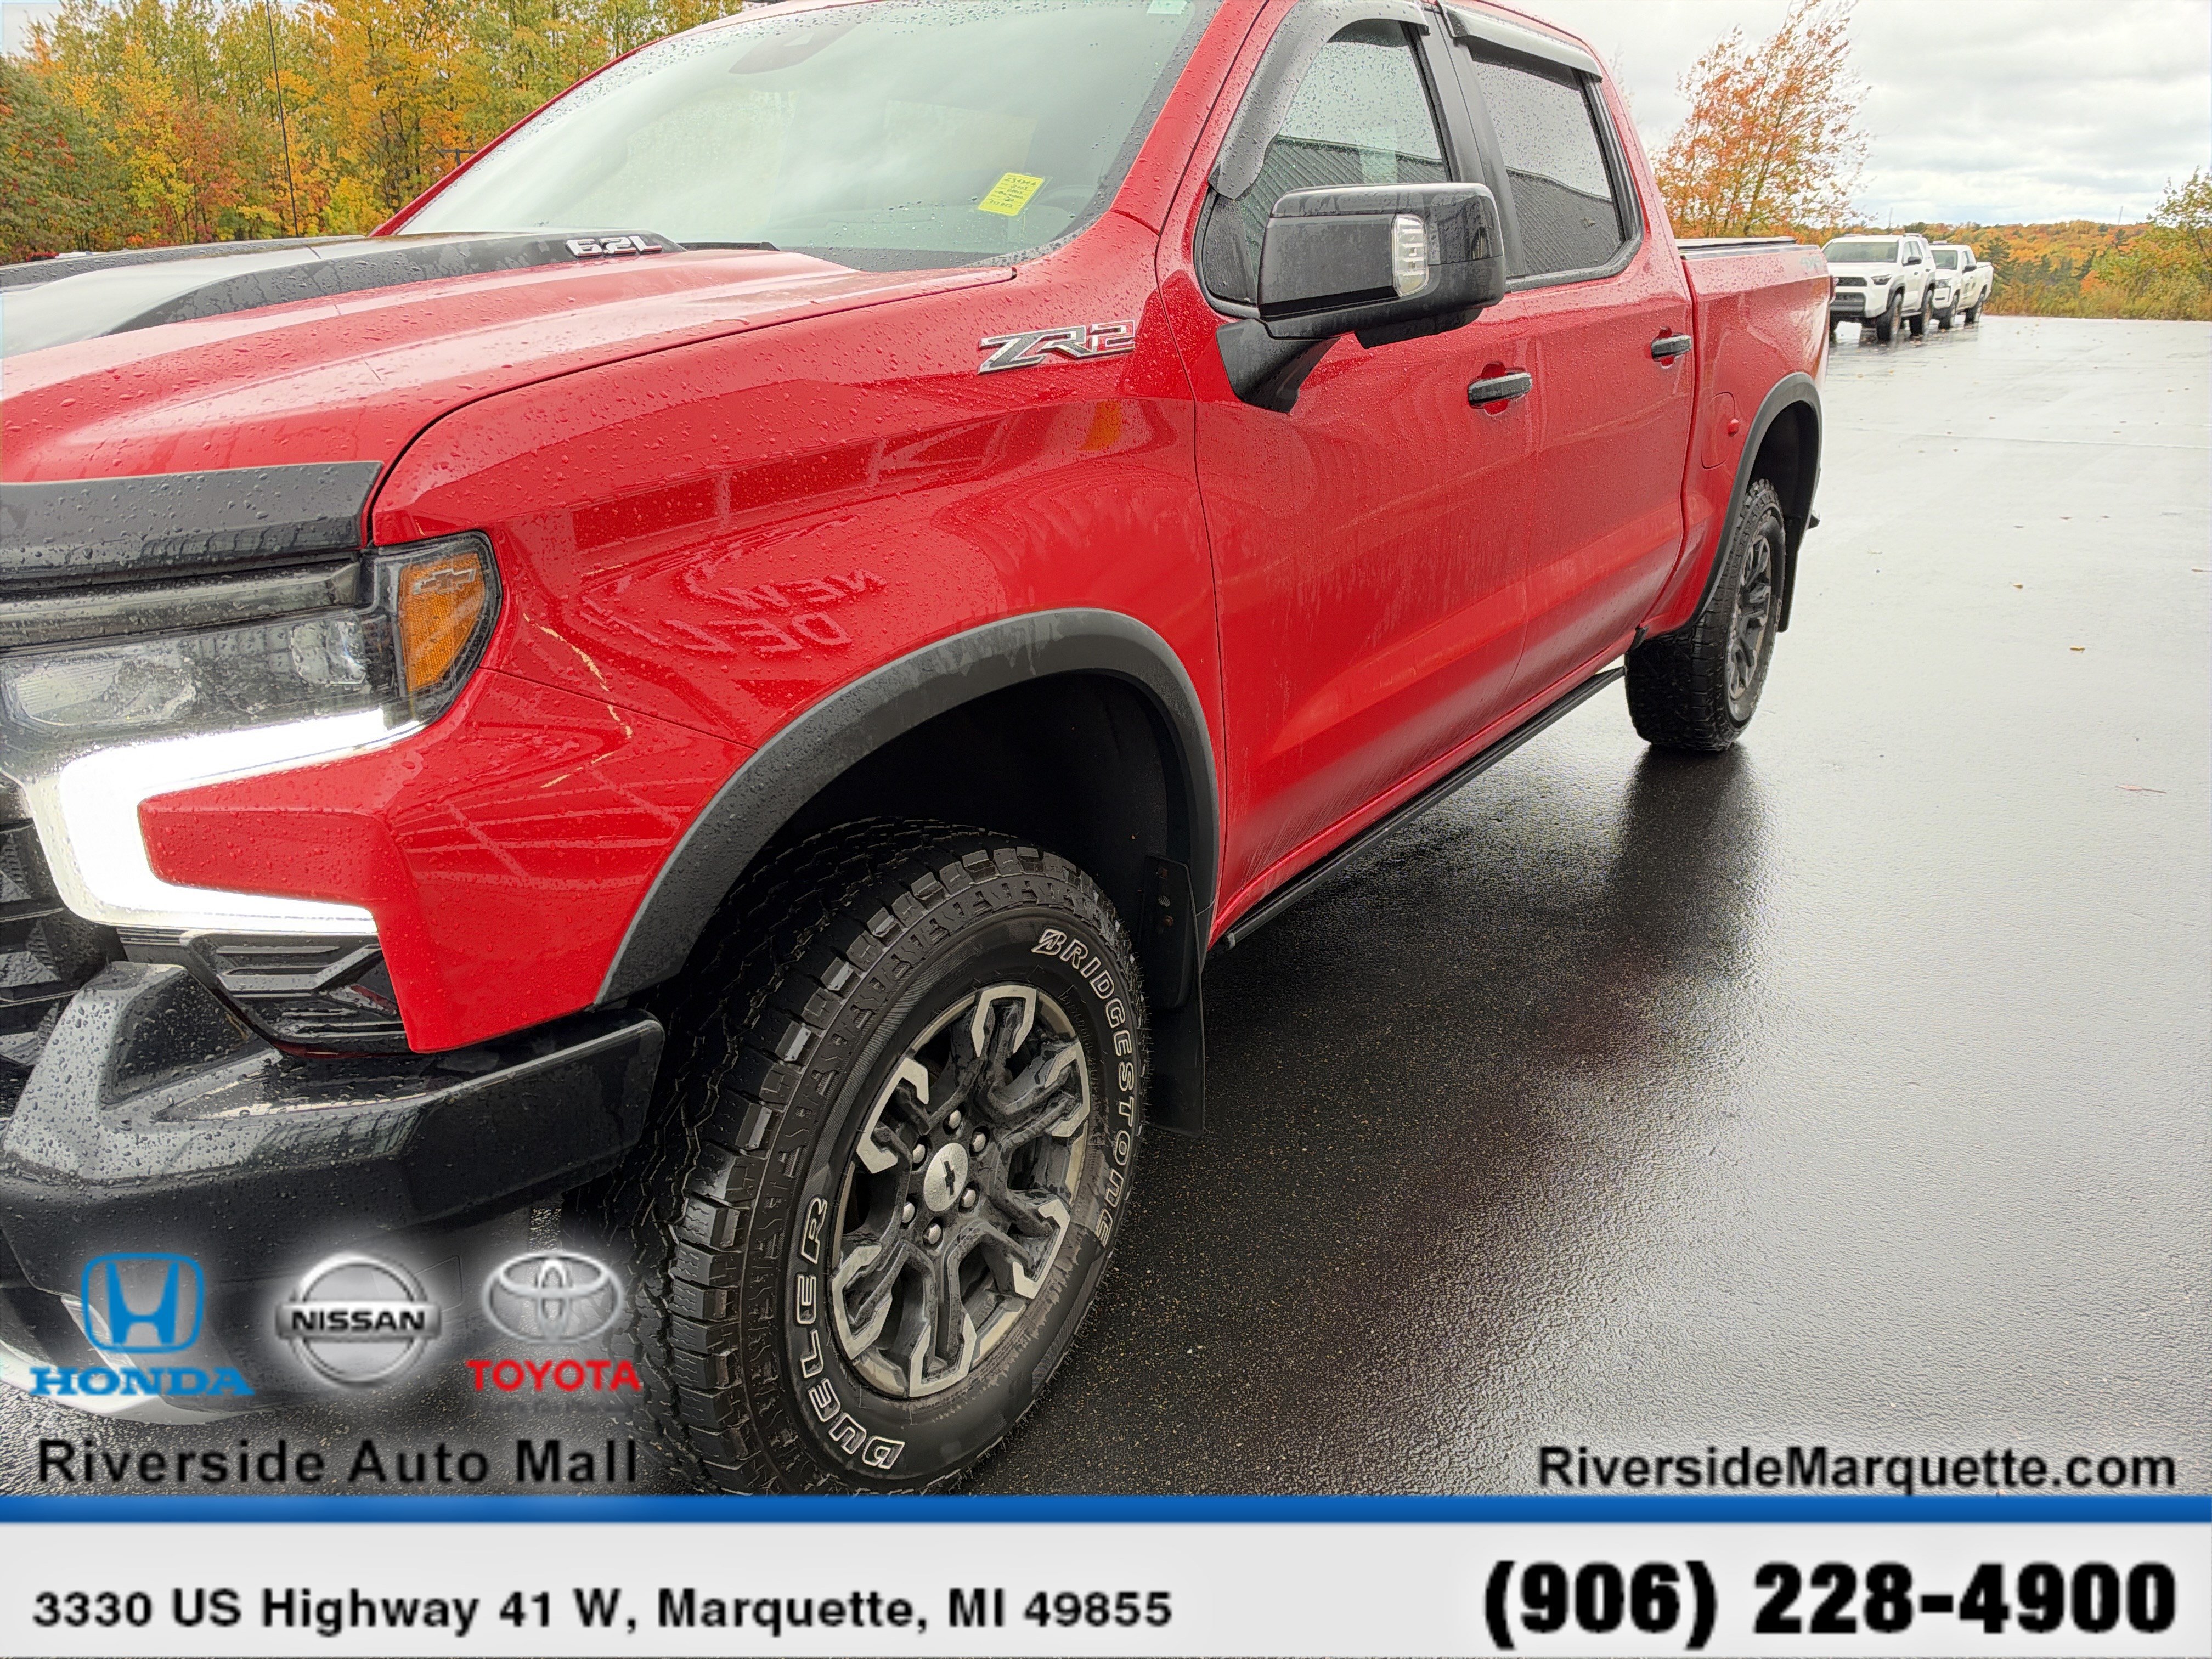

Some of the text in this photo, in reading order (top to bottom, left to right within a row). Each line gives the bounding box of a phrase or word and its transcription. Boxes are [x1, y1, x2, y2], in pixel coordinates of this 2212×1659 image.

[977, 319, 1136, 375] ZR2
[1031, 928, 1133, 1248] BRIDGESTONE
[798, 1197, 906, 1470] DUELER
